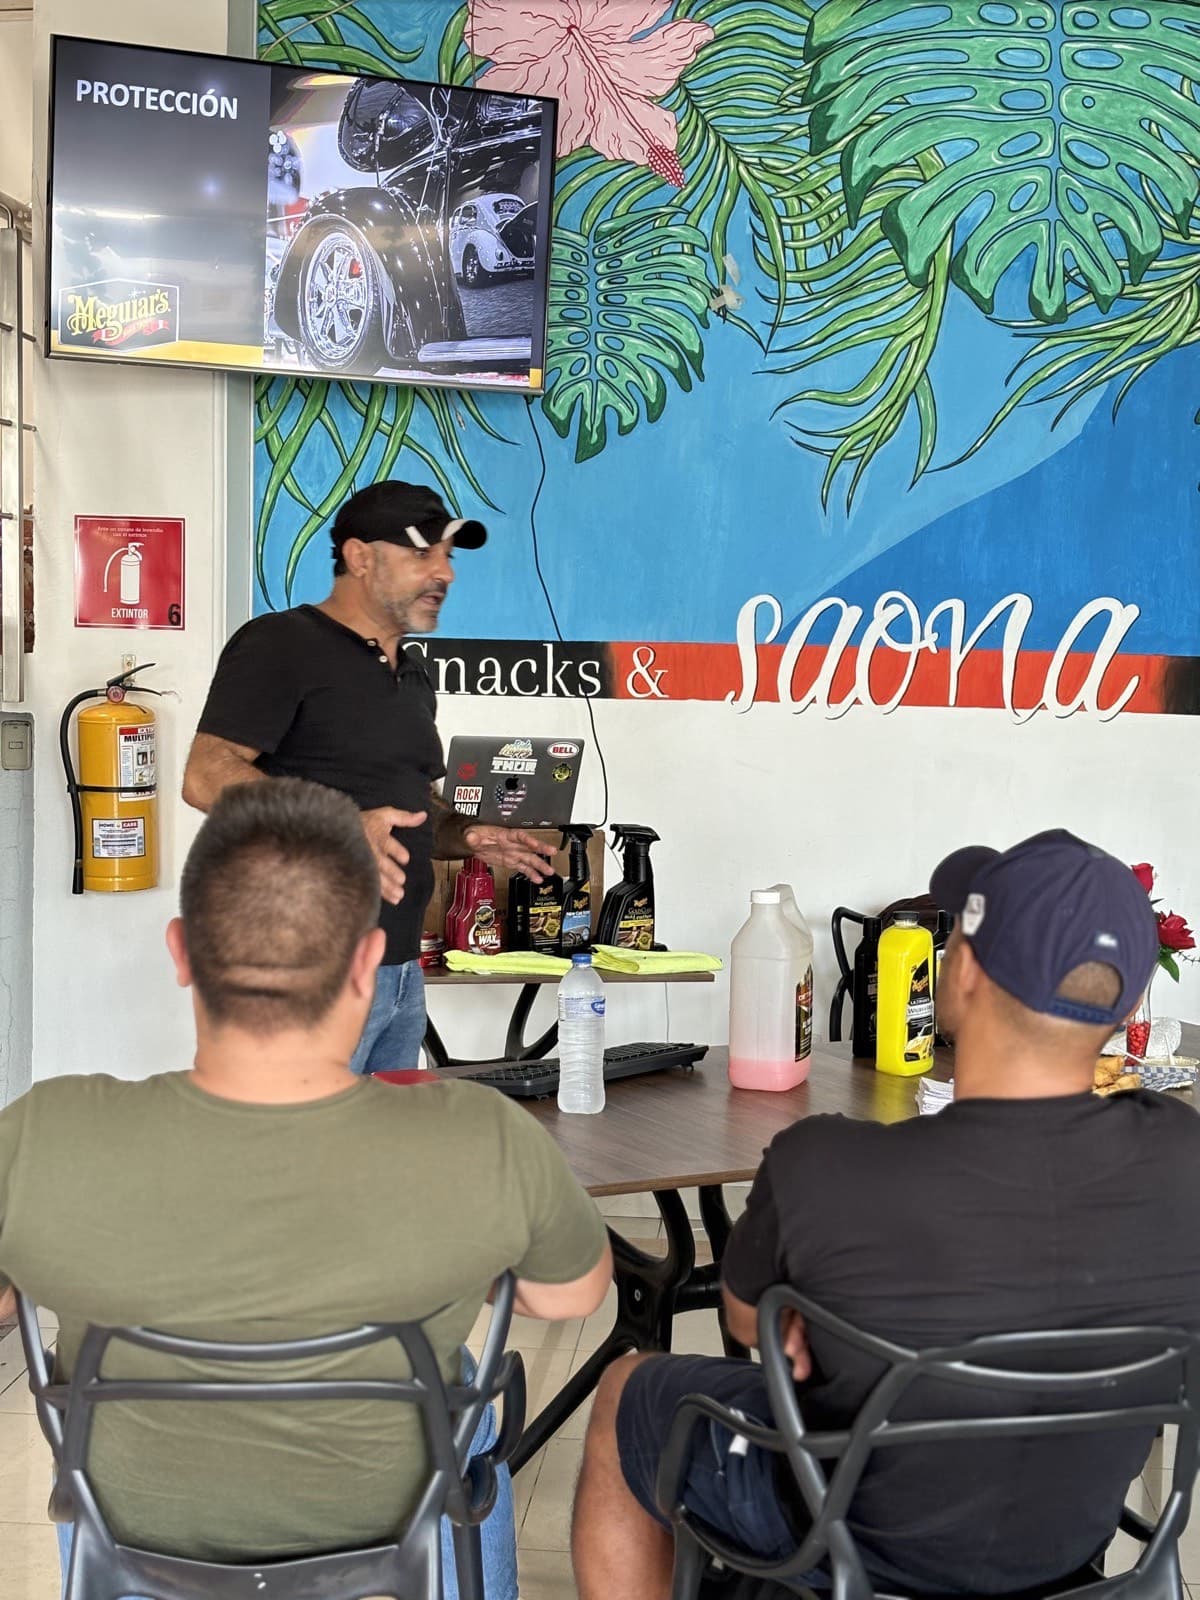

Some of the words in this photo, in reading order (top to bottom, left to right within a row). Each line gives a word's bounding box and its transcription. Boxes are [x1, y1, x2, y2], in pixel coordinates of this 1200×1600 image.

[76, 79, 238, 119] PROTECCIÓN
[111, 607, 149, 619] EXTINTOR
[168, 603, 181, 626] 6
[626, 646, 671, 699] &
[552, 746, 574, 754] BELL
[456, 788, 481, 801] ROCK
[479, 935, 497, 945] WAX
